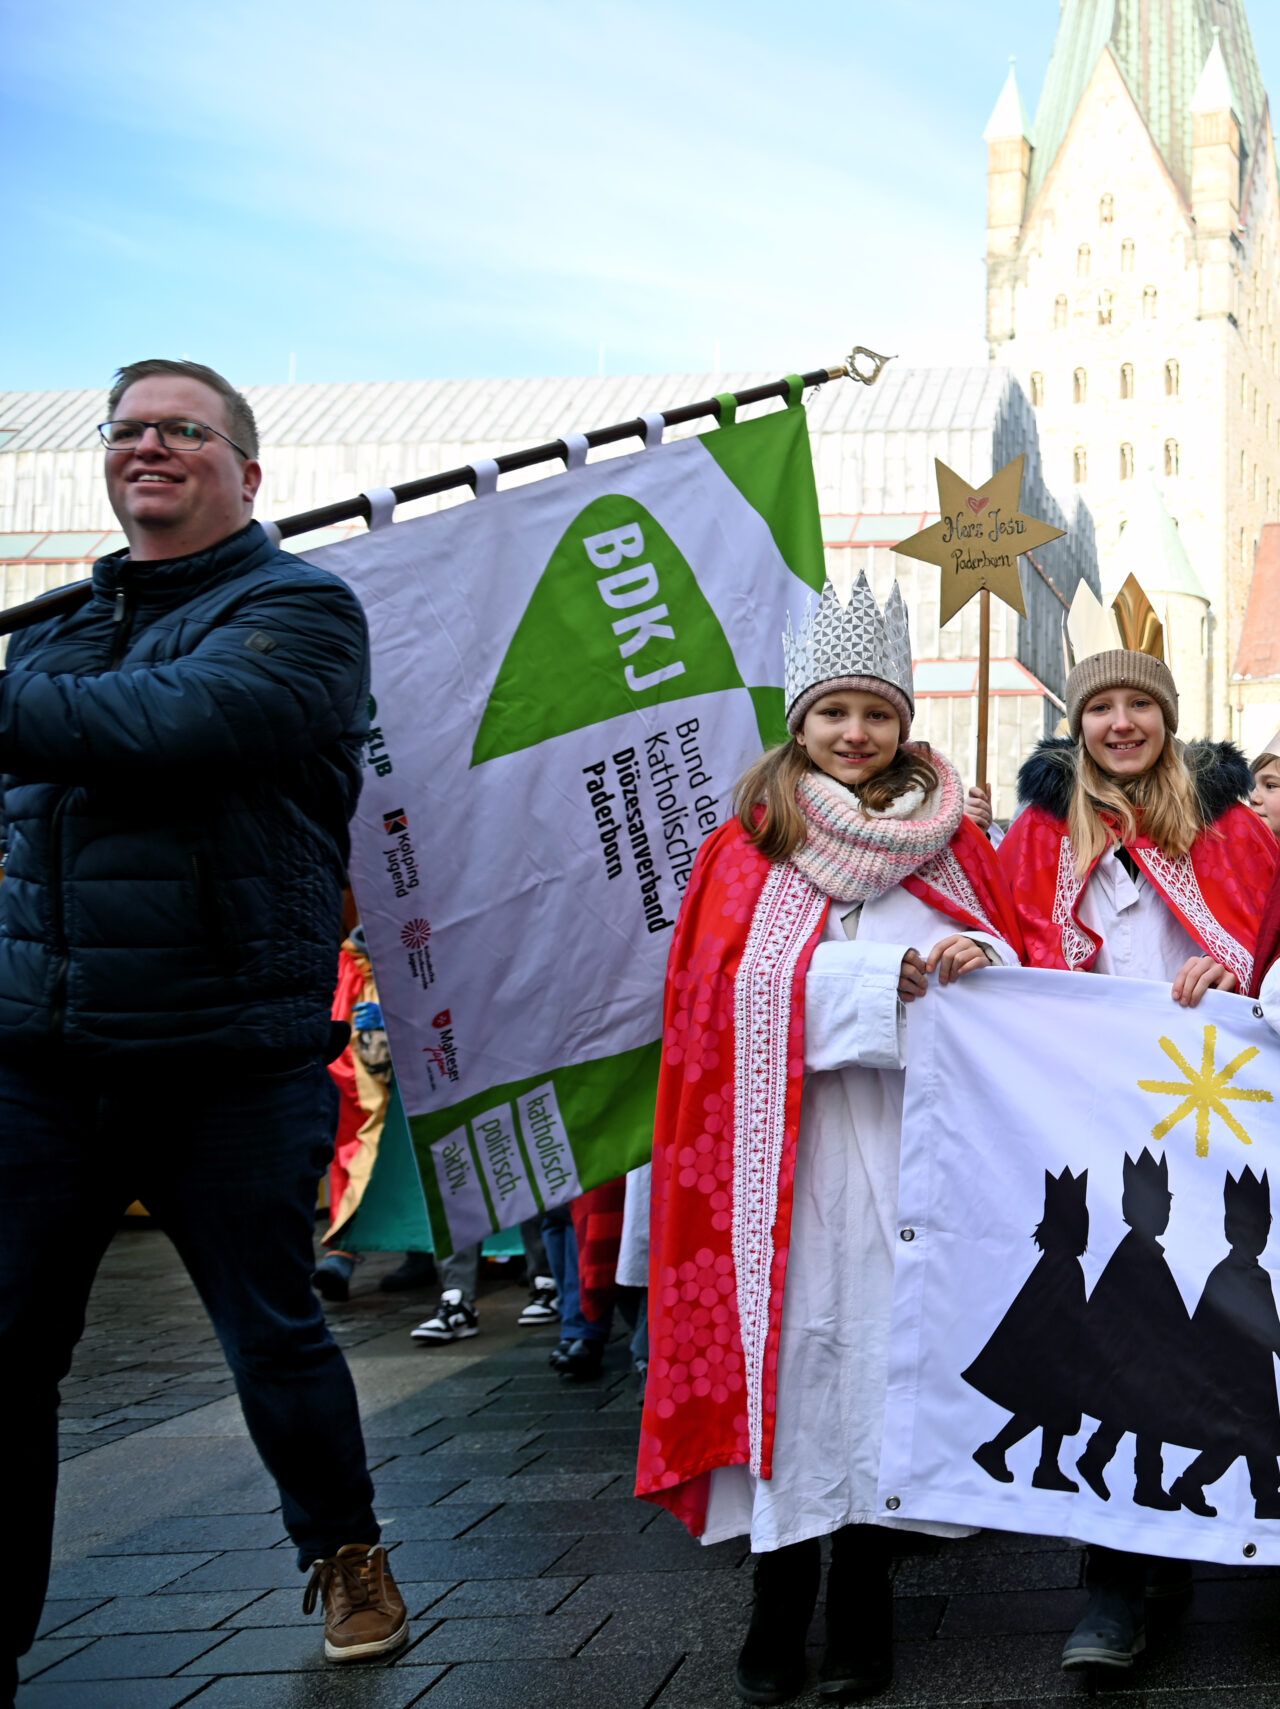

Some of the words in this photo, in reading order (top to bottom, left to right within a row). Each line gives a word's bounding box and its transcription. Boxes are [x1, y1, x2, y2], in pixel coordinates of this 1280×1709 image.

[942, 511, 983, 543] Herz
[988, 508, 1027, 542] Jesu
[951, 547, 1013, 575] Paderborn
[582, 522, 686, 692] BDKJ
[367, 727, 393, 777] KLJB
[675, 717, 713, 789] Bund
[582, 760, 623, 880] Paderborn
[612, 746, 675, 934] Diözesanverband
[382, 847, 409, 898] jugend
[397, 833, 420, 888] Kolping
[439, 1028, 460, 1082] Malteser
[442, 1141, 471, 1196] aktiv.
[476, 1118, 522, 1201] politisch.
[526, 1093, 572, 1196] katholisch.
